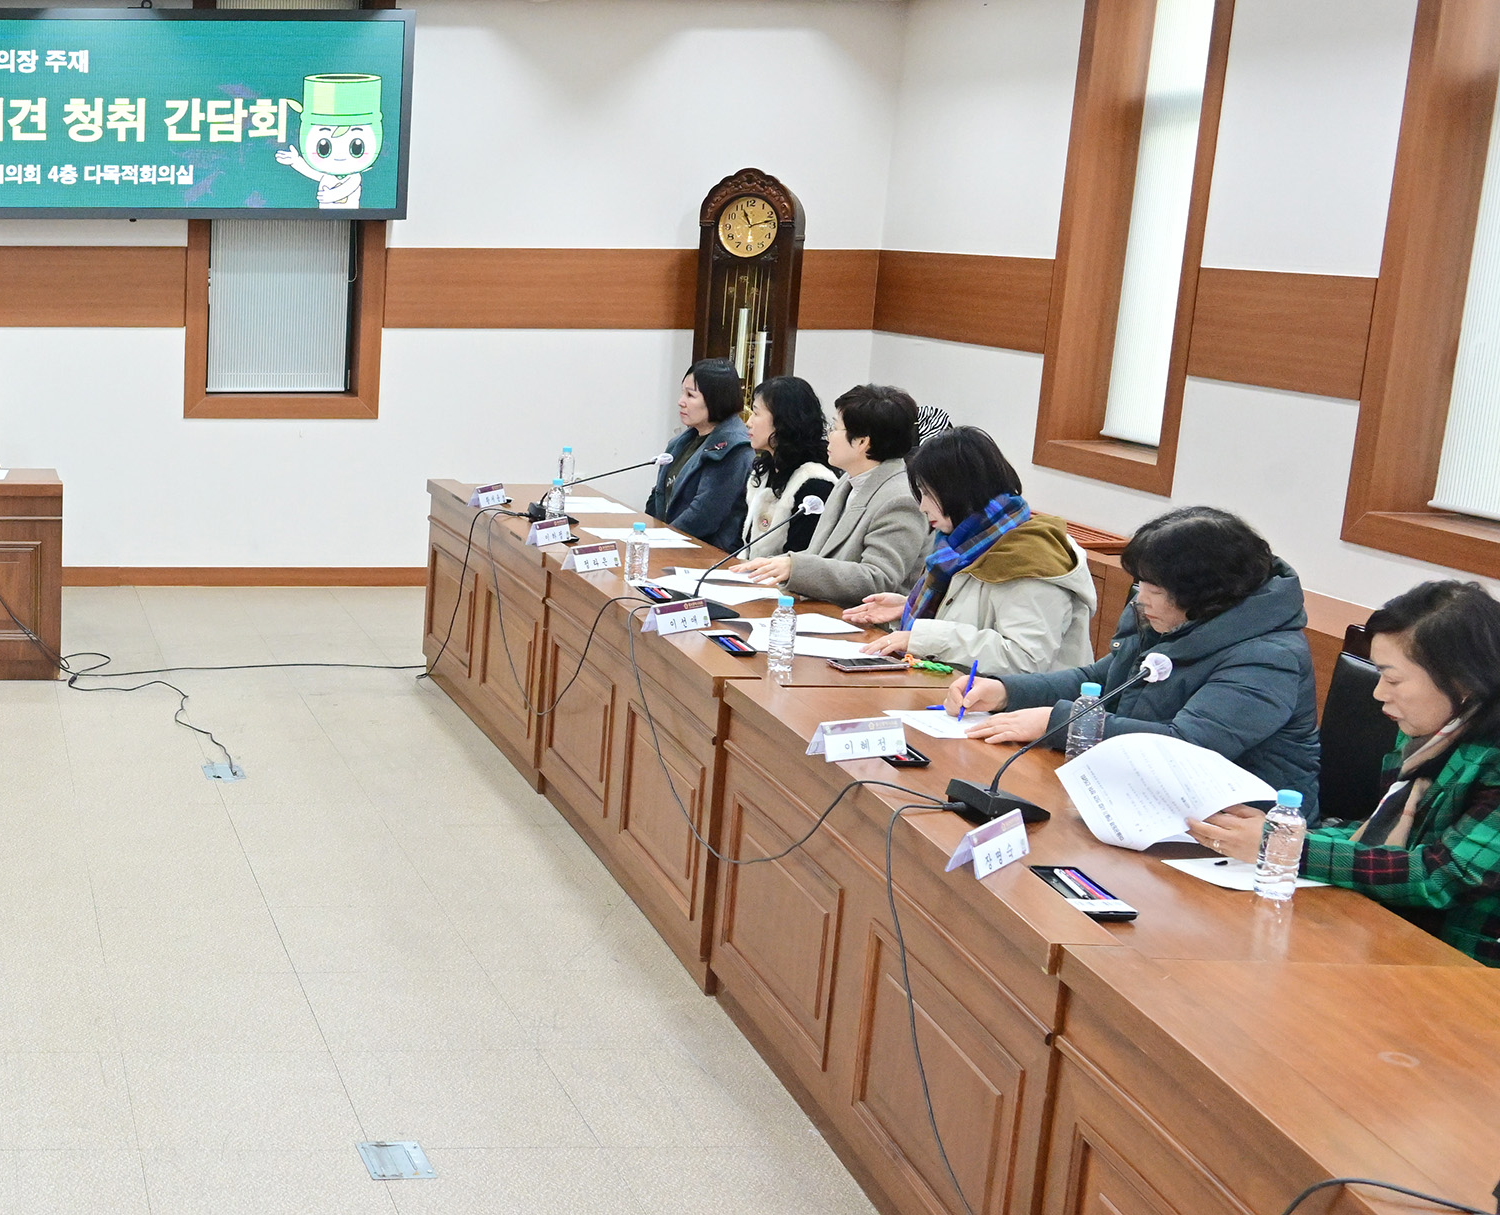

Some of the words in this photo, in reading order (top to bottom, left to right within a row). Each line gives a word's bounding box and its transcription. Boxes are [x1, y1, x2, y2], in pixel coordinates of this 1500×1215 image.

[44, 49, 89, 74] 주재
[62, 97, 146, 143] 청취
[163, 98, 289, 144] 간담회
[47, 164, 79, 185] 4층
[83, 164, 194, 185] 다목적회의실
[746, 199, 756, 208] 12
[728, 212, 736, 220] 10
[725, 223, 731, 231] 9
[769, 221, 776, 229] 3
[746, 244, 753, 252] 6
[757, 241, 764, 249] 5
[844, 736, 887, 755] 이혜정
